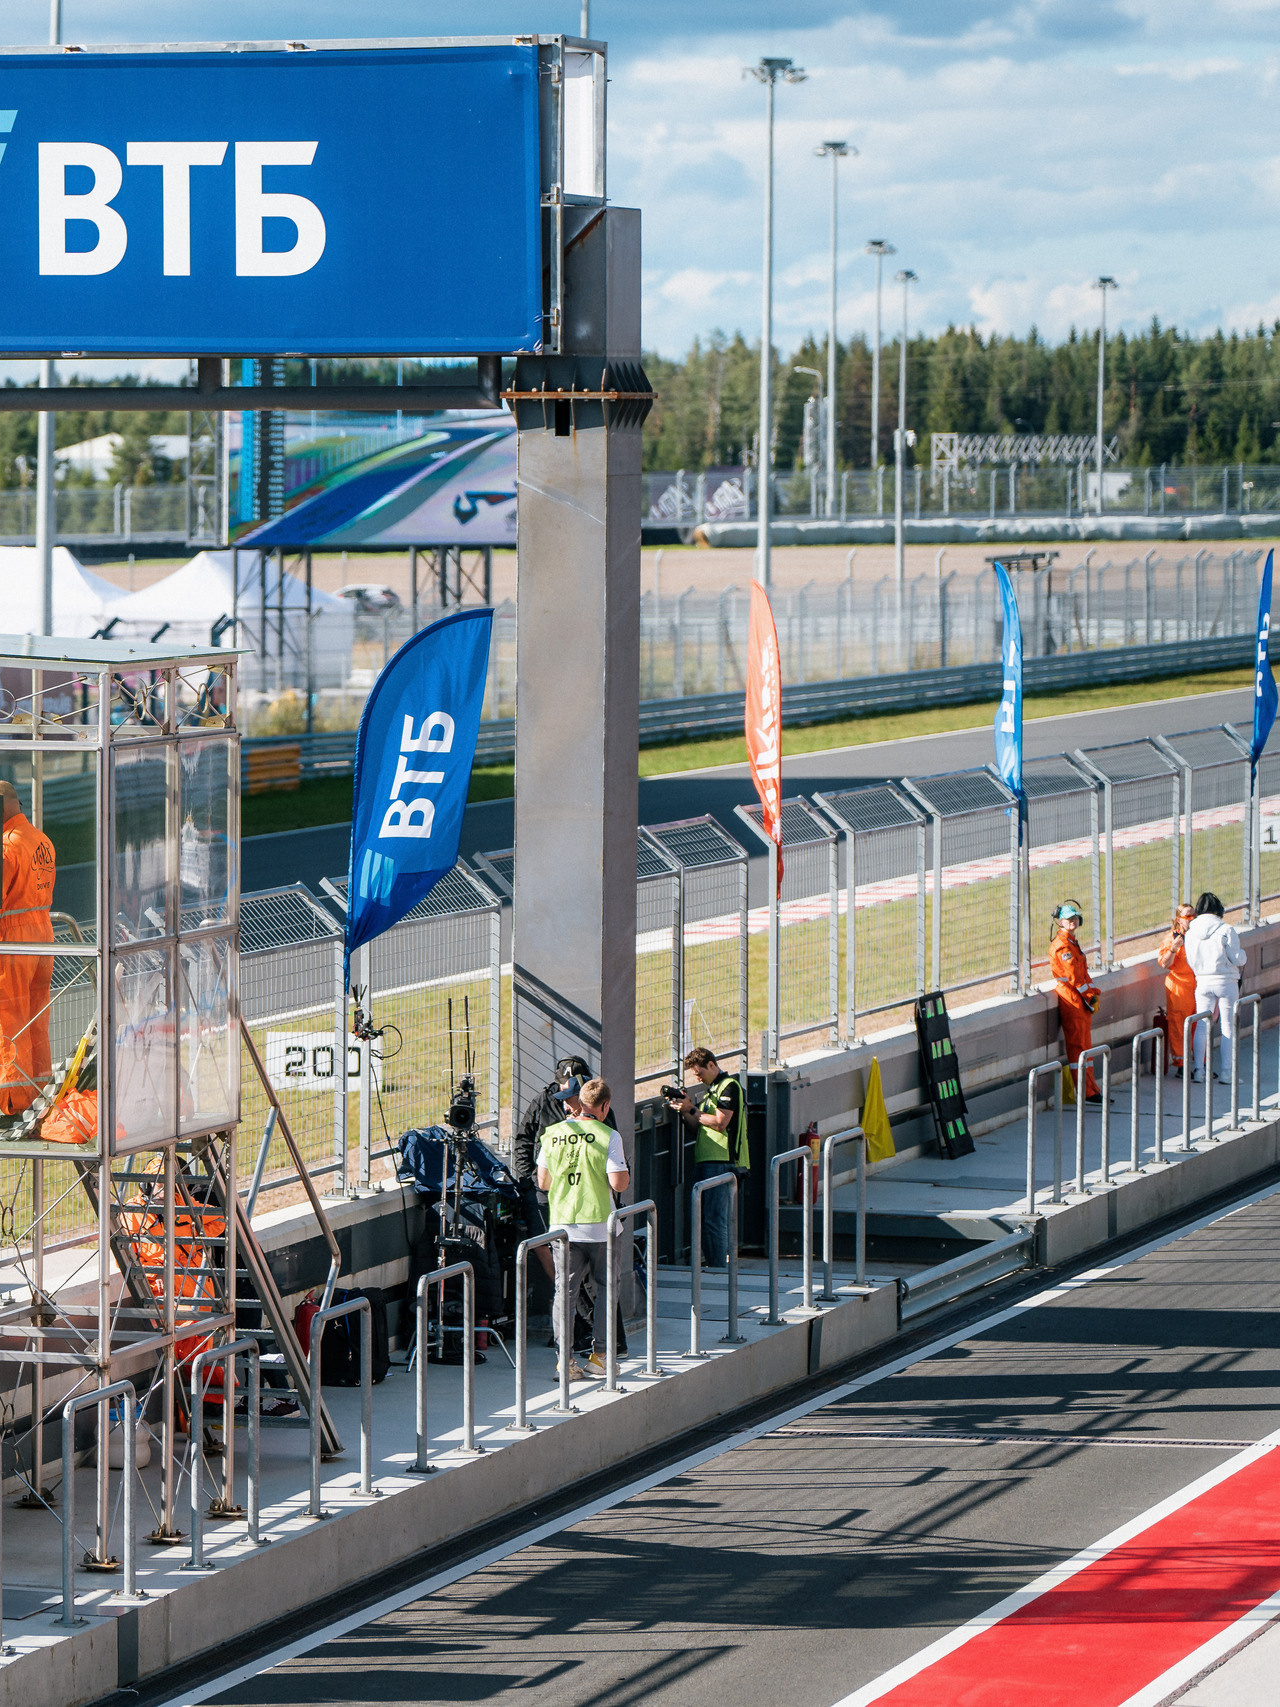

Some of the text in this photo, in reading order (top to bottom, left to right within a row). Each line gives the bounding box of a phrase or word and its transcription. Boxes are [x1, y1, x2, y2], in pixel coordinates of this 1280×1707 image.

[36, 140, 327, 278] ВТБ
[378, 711, 455, 838] ВТБ
[285, 1047, 361, 1077] 200
[552, 1133, 596, 1147] PHOTO
[568, 1173, 582, 1186] 07
